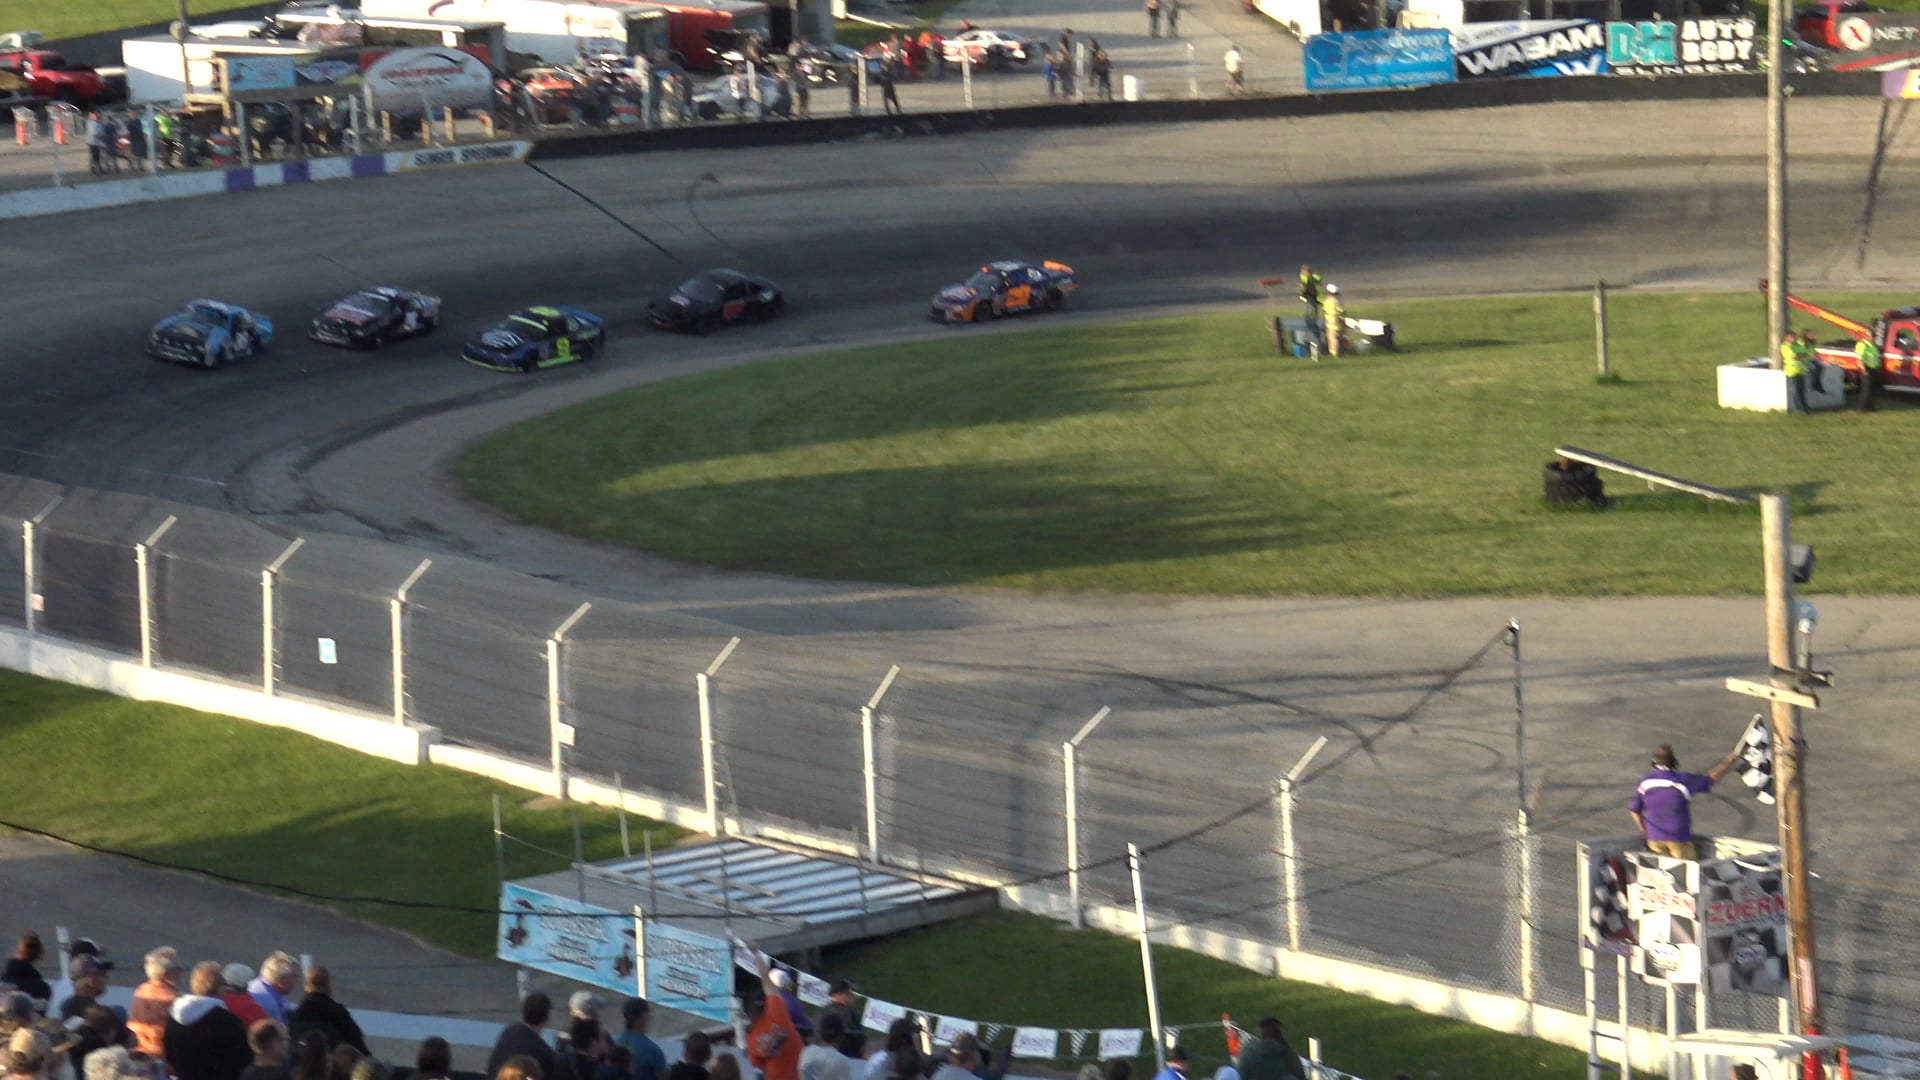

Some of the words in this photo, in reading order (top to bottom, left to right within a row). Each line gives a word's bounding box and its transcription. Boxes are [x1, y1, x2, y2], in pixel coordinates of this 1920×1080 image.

[1681, 18, 1756, 41] AUTO
[1457, 22, 1605, 76] WABAM
[1681, 39, 1753, 63] BODY
